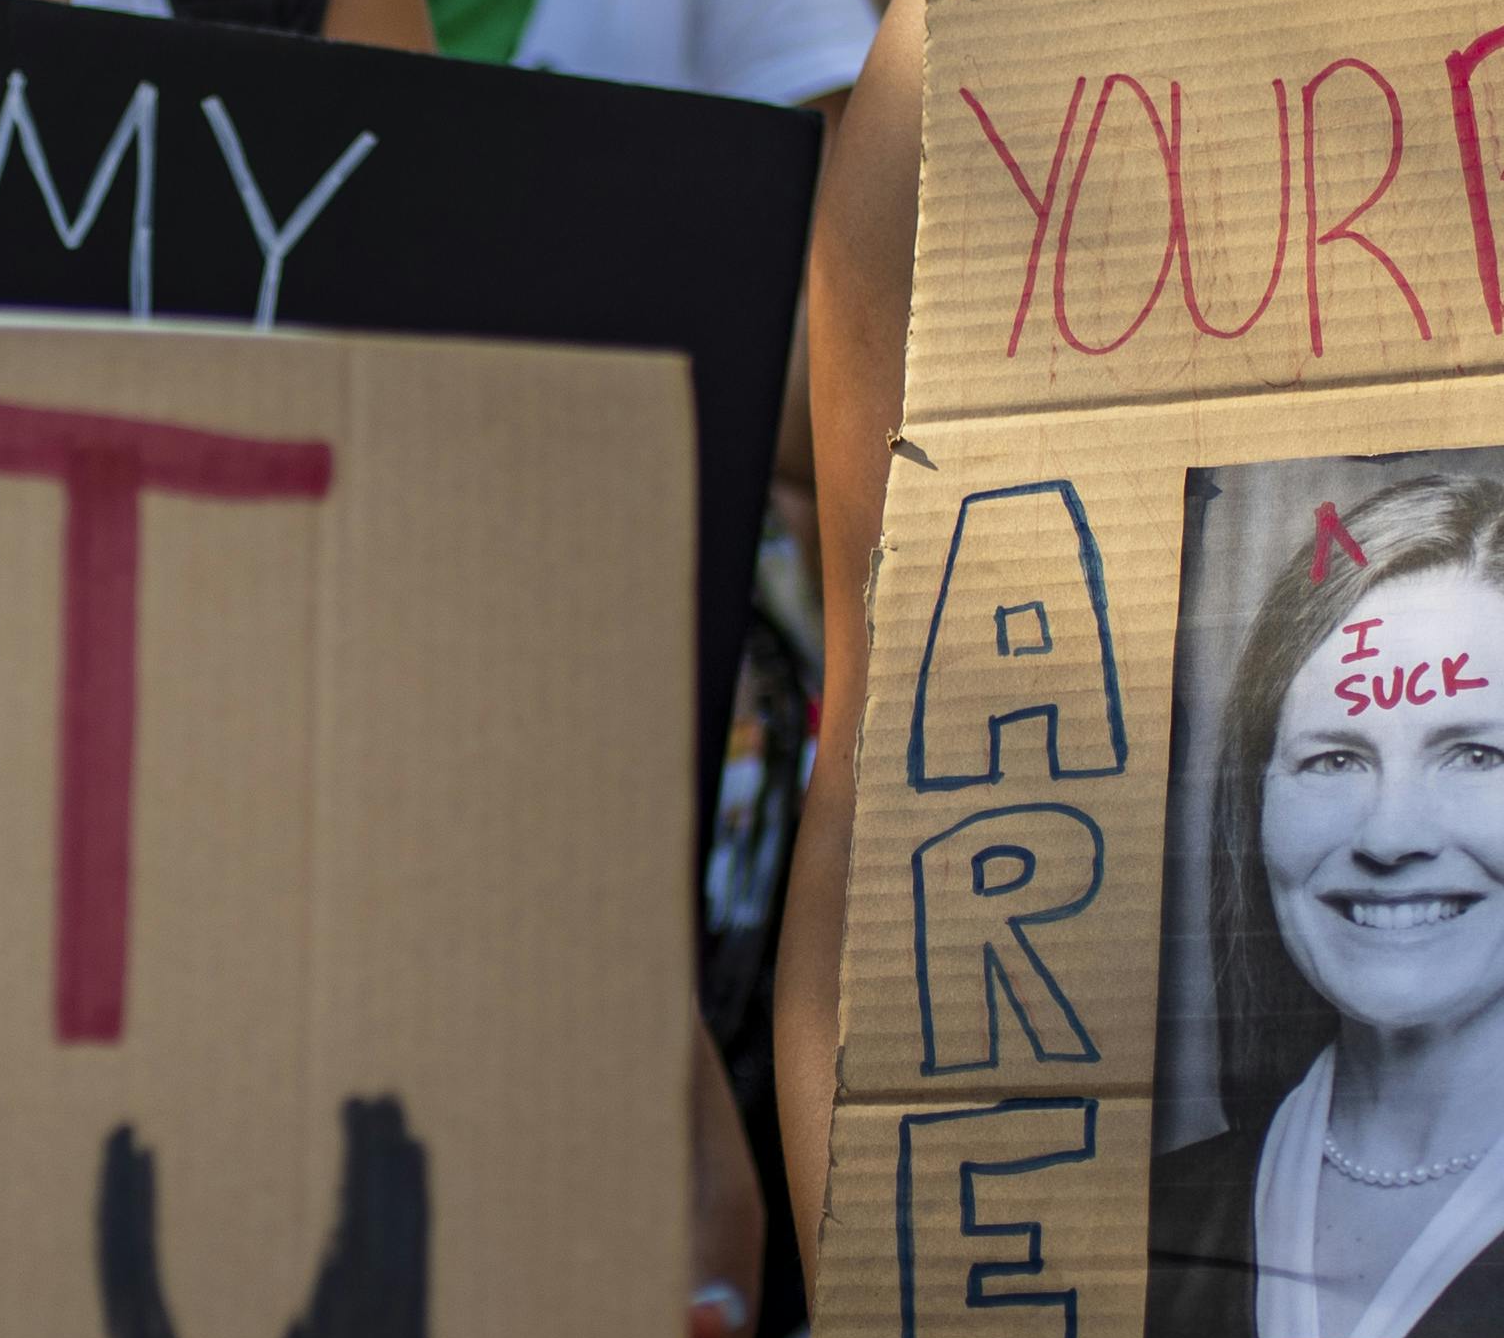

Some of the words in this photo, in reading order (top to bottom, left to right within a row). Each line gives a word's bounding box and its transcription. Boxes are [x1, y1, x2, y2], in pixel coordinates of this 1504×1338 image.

[958, 57, 1434, 359] YOUR
[1341, 618, 1384, 664] I
[1334, 652, 1489, 716] SUCK
